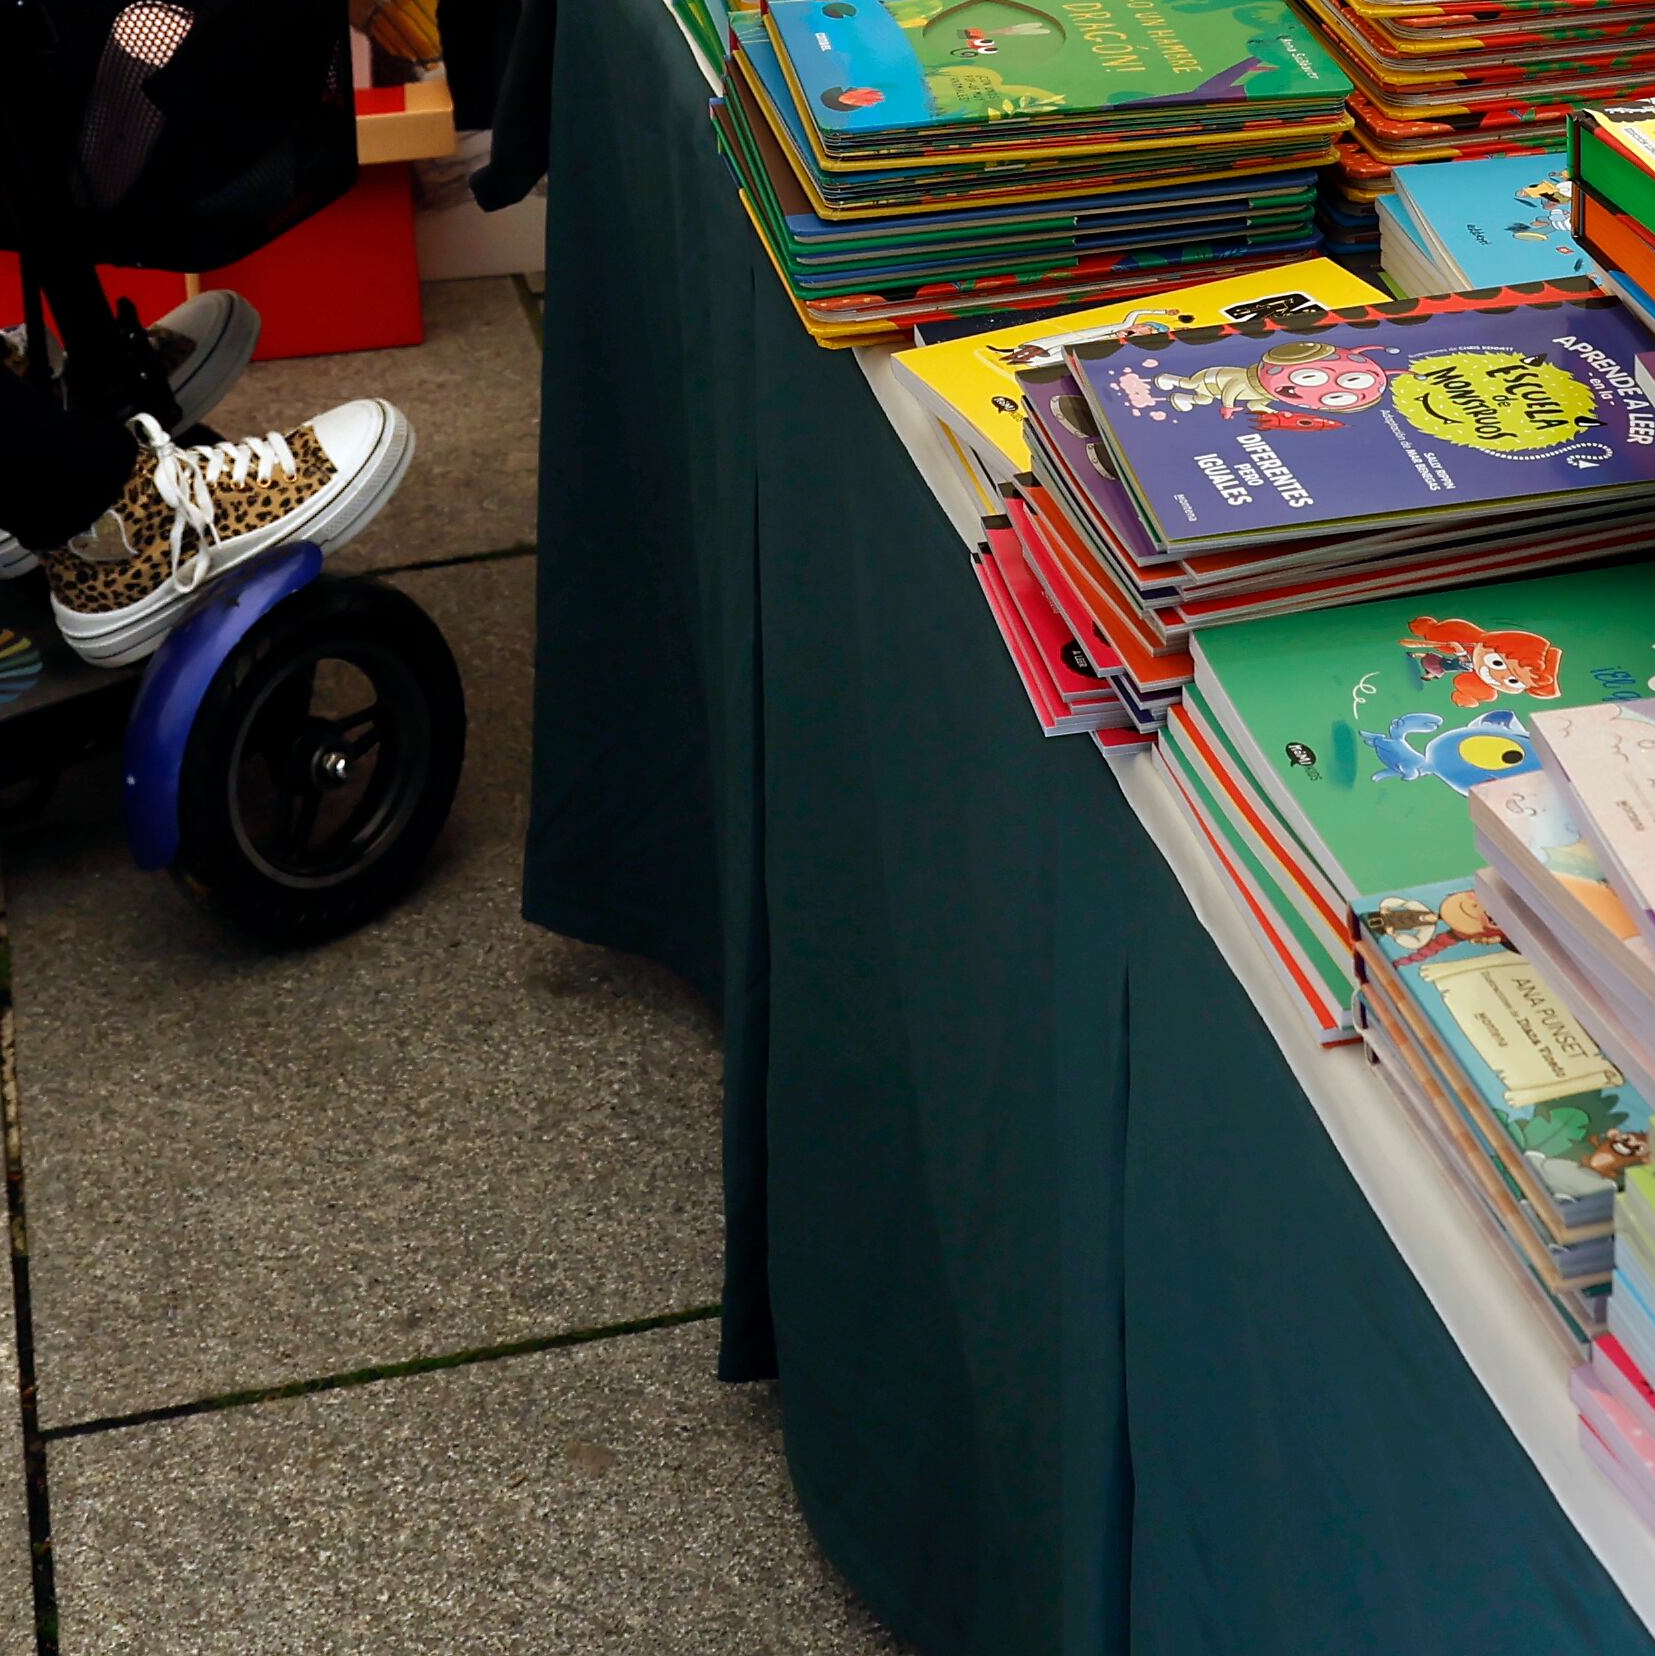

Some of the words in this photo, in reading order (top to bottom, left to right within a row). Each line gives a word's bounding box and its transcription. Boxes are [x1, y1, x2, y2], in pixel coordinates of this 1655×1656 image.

[1062, 2, 1147, 73] DRAGÓN!
[1134, 11, 1166, 26] UN
[1148, 28, 1204, 75] HAMBRE
[1424, 365, 1519, 442] MONSTRUOS
[1485, 363, 1571, 432] ESCUELA
[1491, 394, 1511, 409] de
[1551, 335, 1645, 397] APRENDE
[1622, 397, 1650, 411] A
[1588, 377, 1605, 393] en
[1193, 452, 1253, 507] IGUALES
[1233, 462, 1265, 488] PERO
[1236, 432, 1314, 509] DIFERENTES
[1511, 977, 1546, 1009] ANA
[1535, 1007, 1590, 1060] PUNSET
